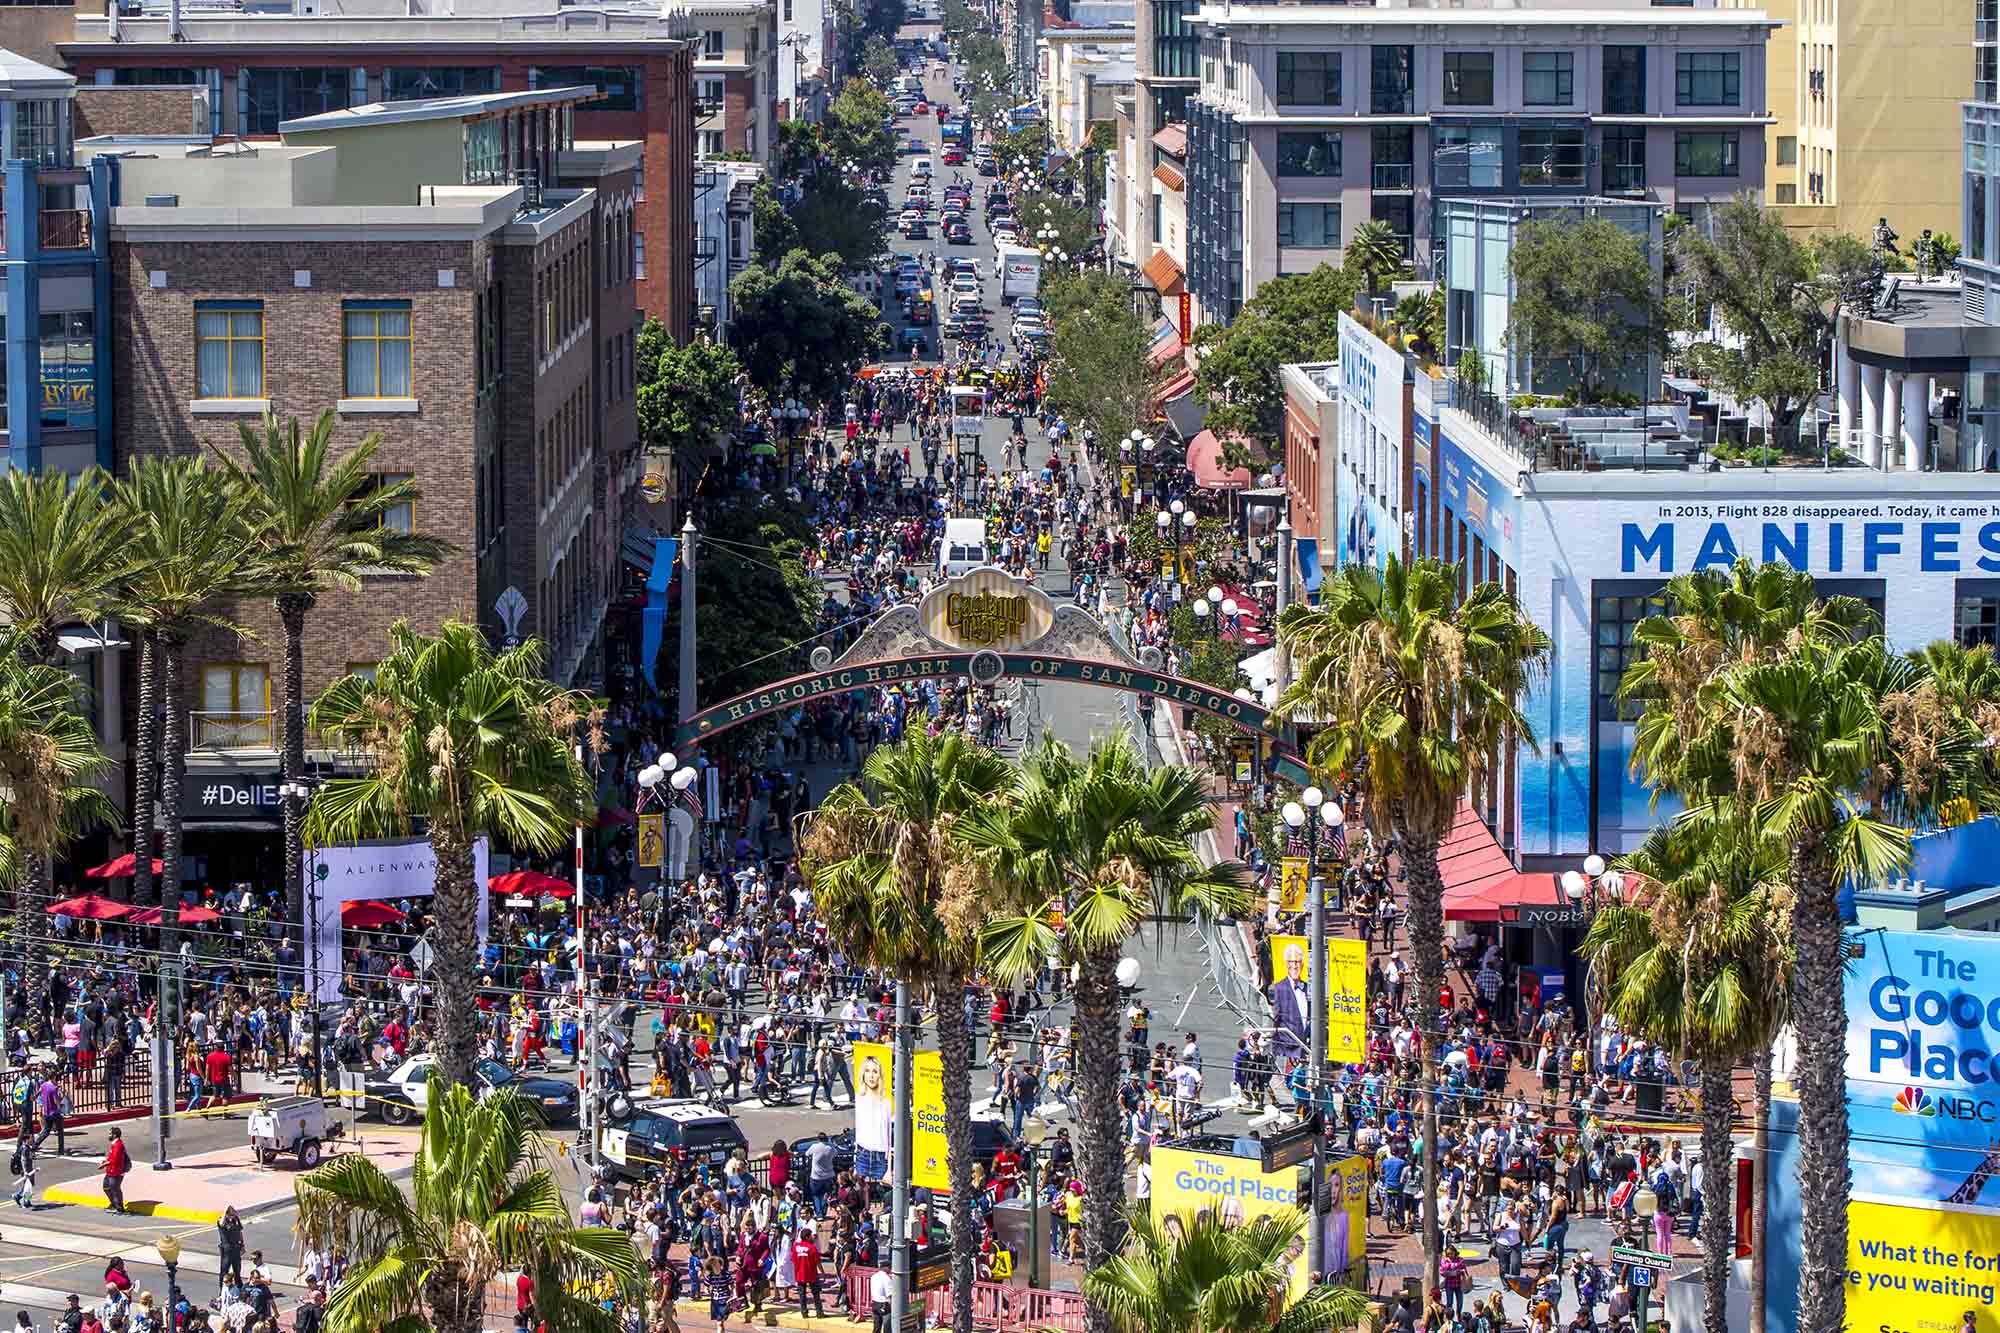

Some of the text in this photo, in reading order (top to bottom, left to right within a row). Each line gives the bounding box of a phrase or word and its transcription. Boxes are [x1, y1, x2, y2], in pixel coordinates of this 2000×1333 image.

[1659, 506, 1671, 517] In
[1676, 506, 1713, 519] 2013,
[1717, 505, 1758, 519] Flight
[1762, 506, 1788, 517] 828
[1793, 505, 1882, 519] disappeared.
[1888, 506, 1932, 519] Today,
[1936, 506, 1946, 517] it
[1950, 508, 1987, 517] came
[727, 659, 1242, 721] HISTORIC HEART OF SAN DIEGO
[346, 860, 438, 876] ALIENWAR
[1527, 911, 1584, 922] NOBU
[1913, 949, 1977, 981] The
[1333, 993, 1361, 1004] Good
[1333, 1003, 1361, 1013] Place
[1938, 1096, 1997, 1122] NBC
[1195, 1159, 1224, 1175] The
[1175, 1171, 1297, 1205] Good Place
[1614, 1251, 1671, 1268] Gaslamp Quarter
[1859, 1239, 2000, 1273] What the for
[1840, 1269, 1995, 1305] re you waiting
